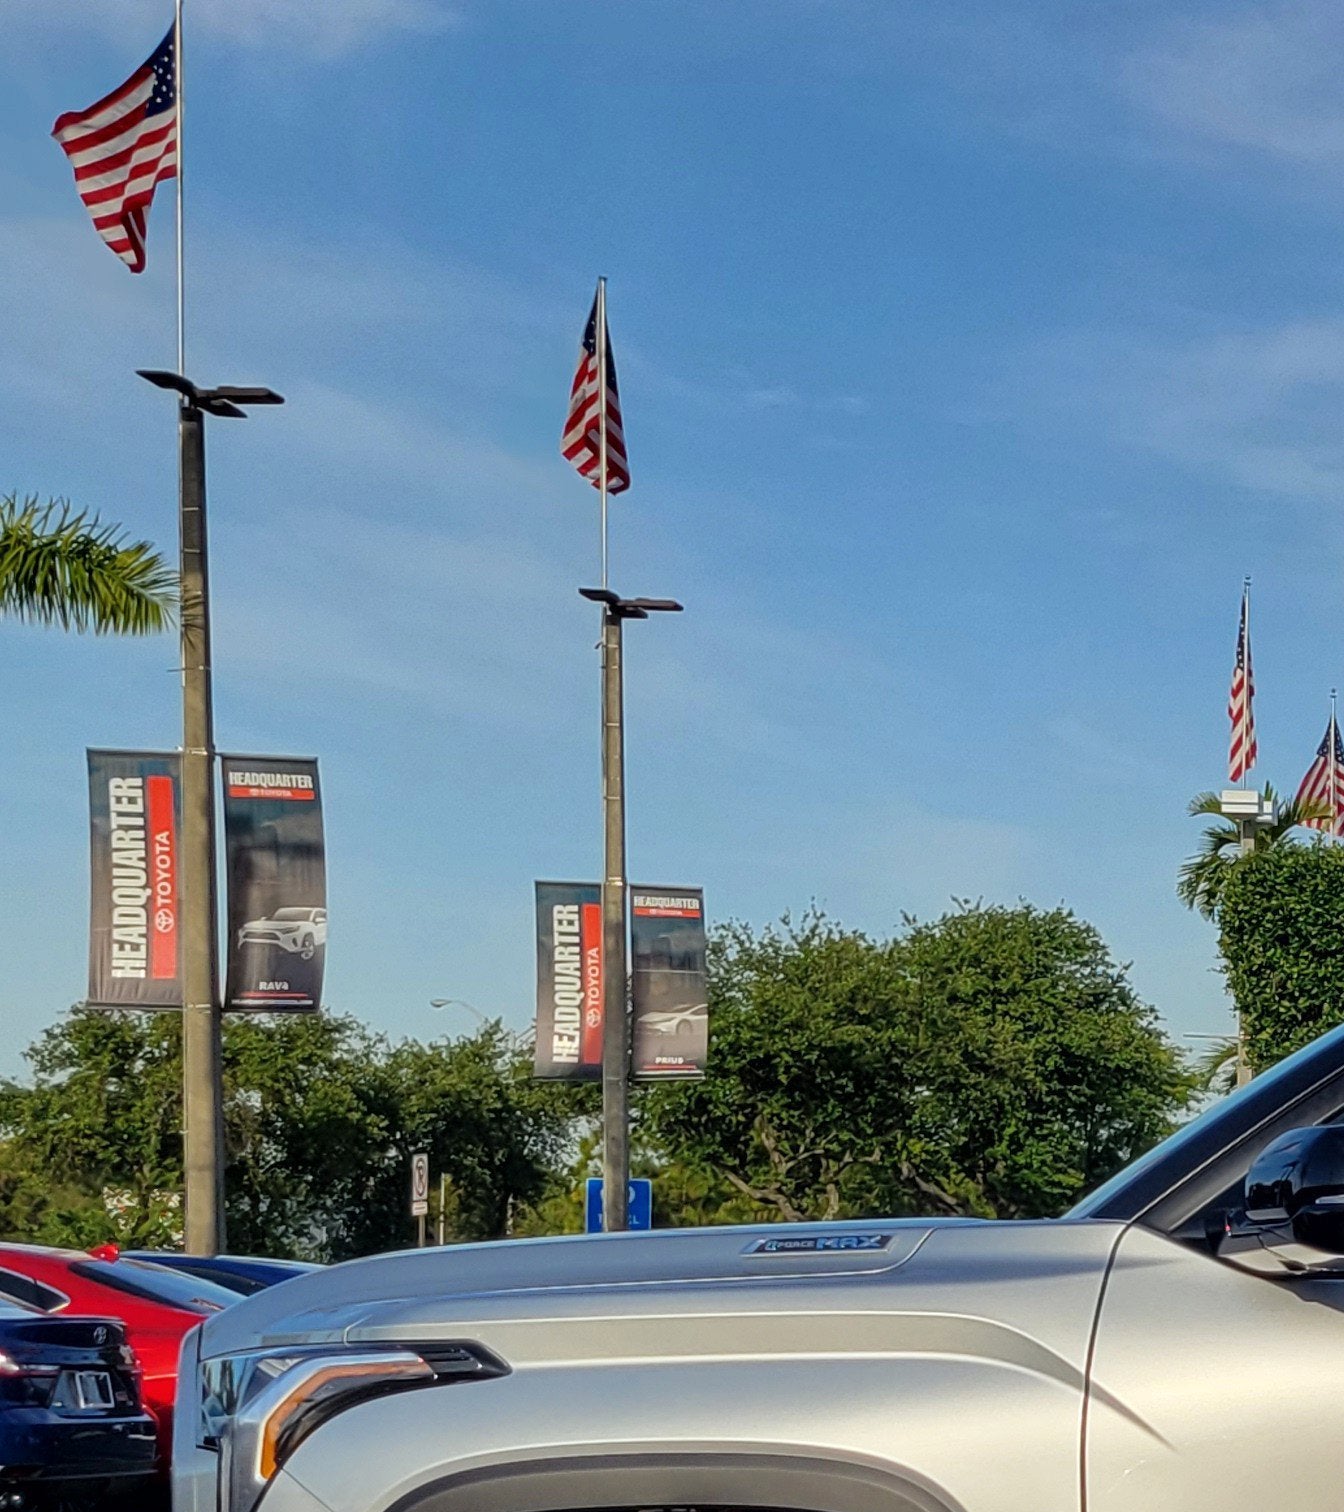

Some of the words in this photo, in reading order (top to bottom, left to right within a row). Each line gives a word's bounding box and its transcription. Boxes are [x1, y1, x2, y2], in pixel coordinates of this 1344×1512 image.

[229, 772, 313, 788] HEADQUARTER
[109, 777, 152, 979] HEADQUARTER
[156, 831, 171, 908] TOYOTA
[259, 981, 289, 991] RAV4
[553, 904, 585, 1063] HEADQUARTER
[587, 947, 600, 1006] TOYOTA
[816, 1235, 882, 1249] MAX
